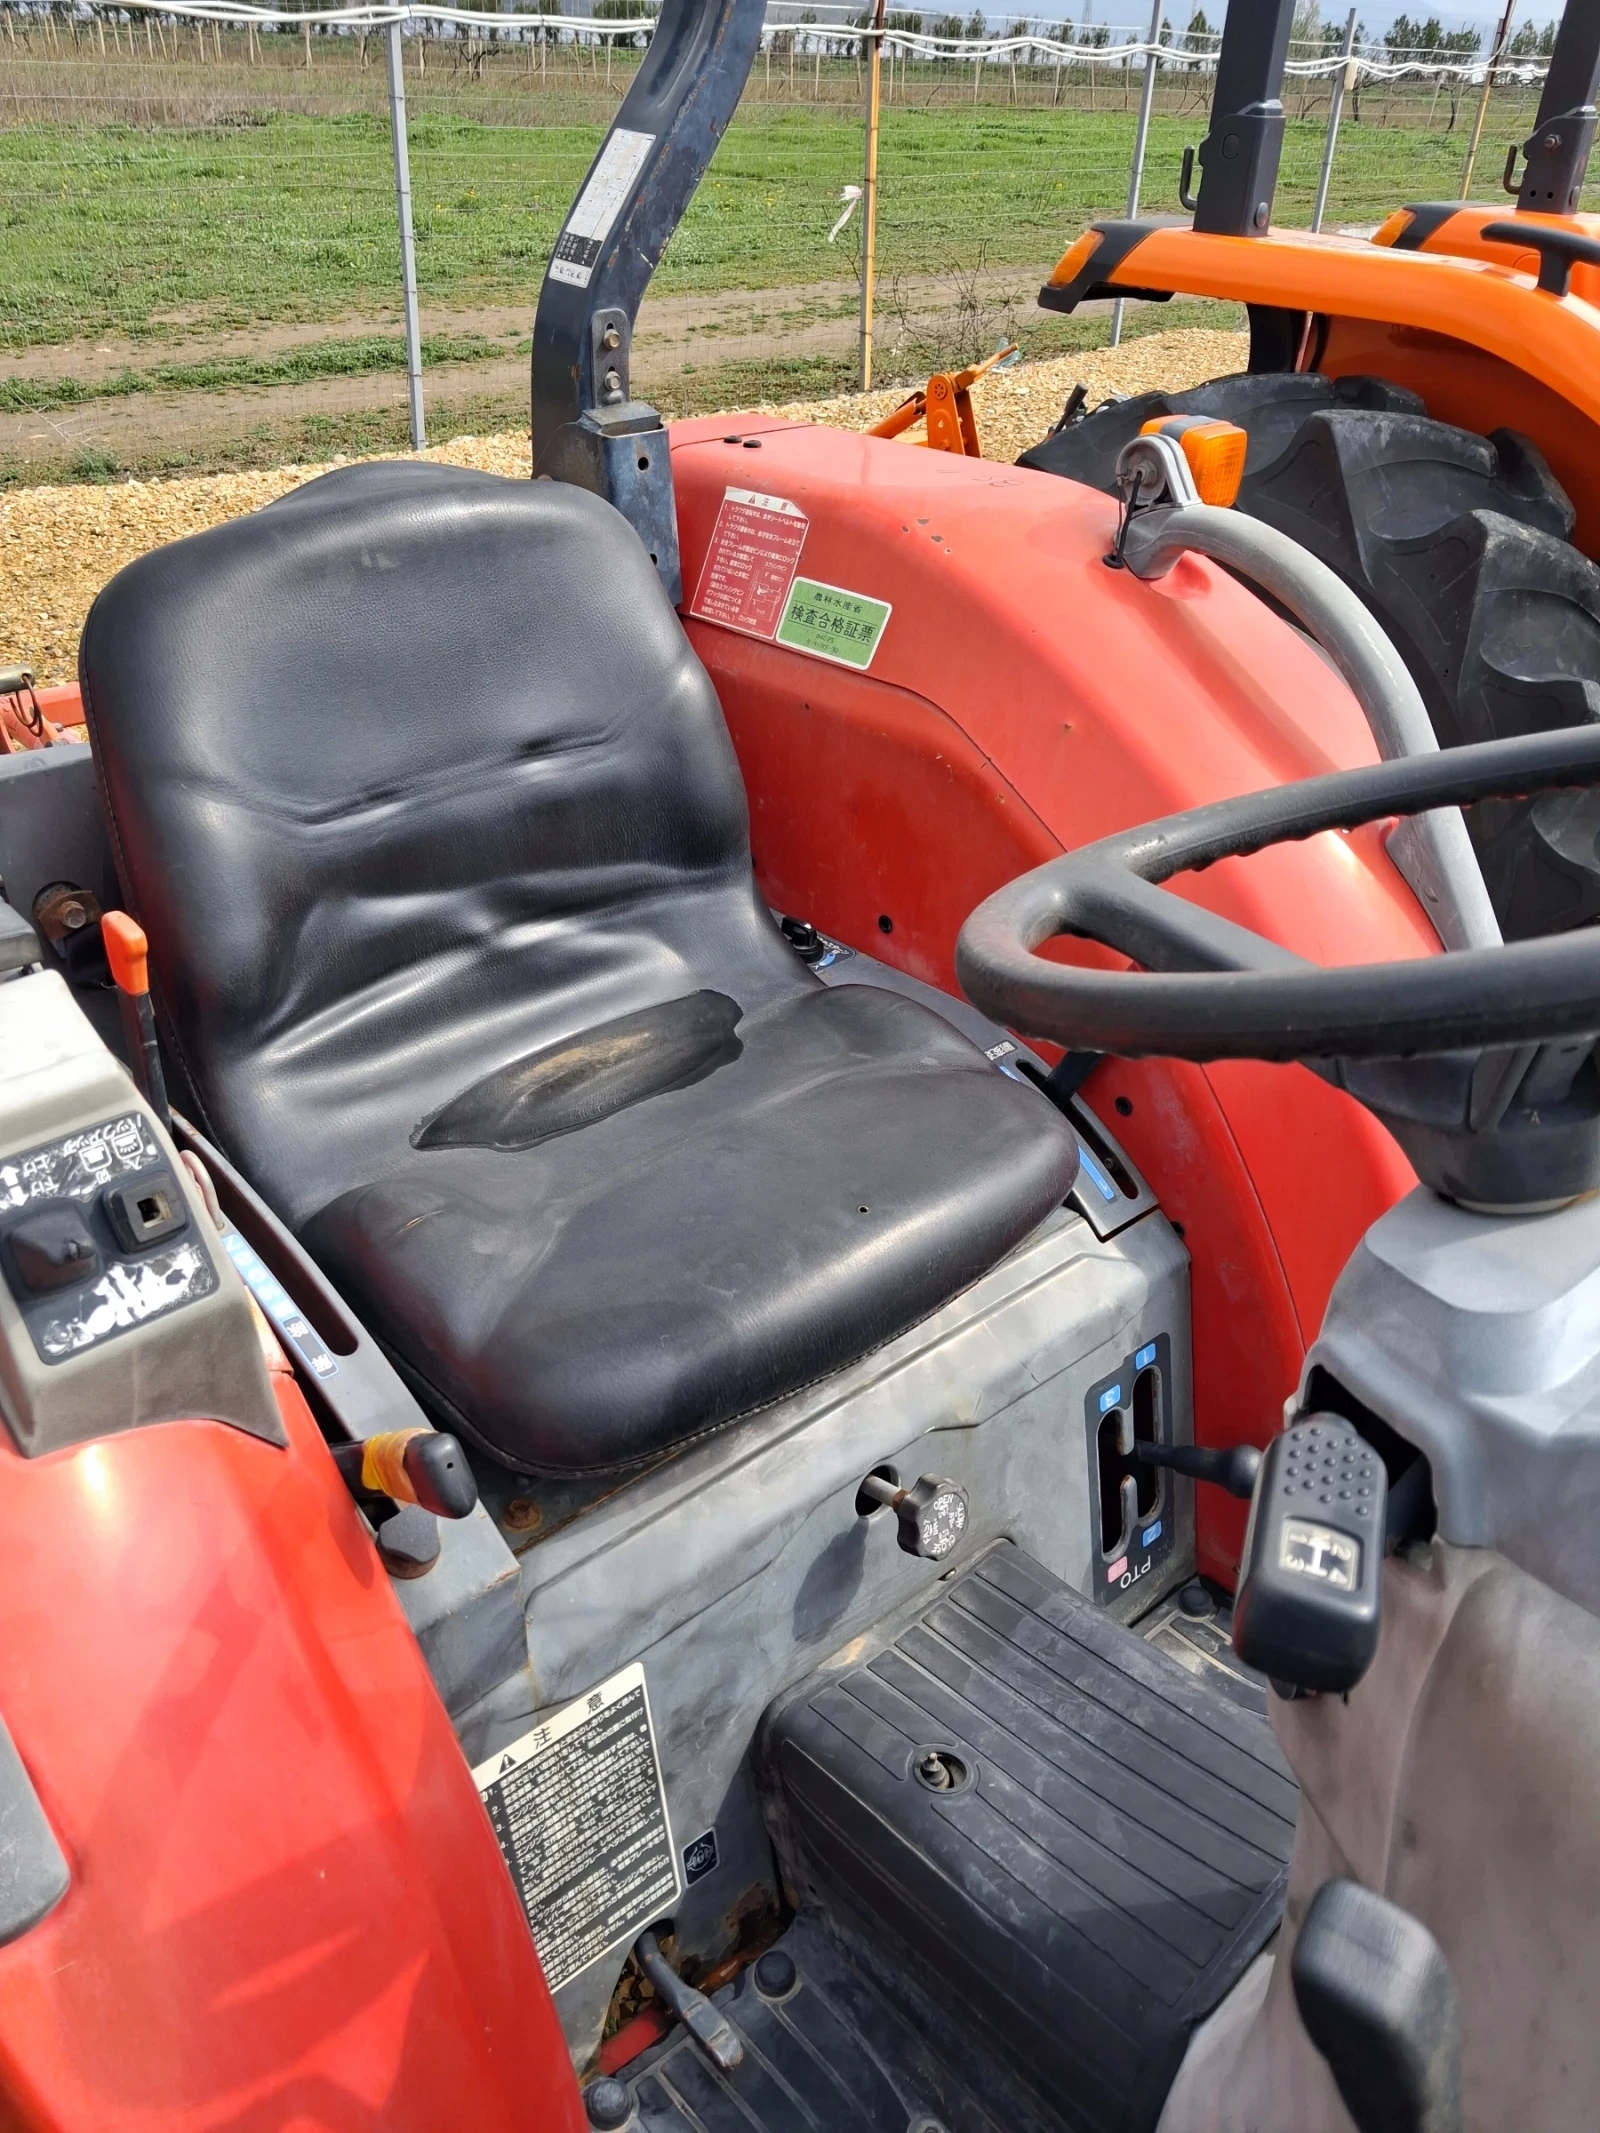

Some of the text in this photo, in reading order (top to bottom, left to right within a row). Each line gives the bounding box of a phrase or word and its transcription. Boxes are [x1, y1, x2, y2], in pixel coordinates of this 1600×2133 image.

[813, 592, 863, 614] 農林水産省
[791, 603, 876, 643] 検査合格証票
[933, 1493, 954, 1511] OPEN
[931, 1534, 956, 1554] CLOSE
[1120, 1554, 1151, 1588] PTO
[533, 1691, 605, 1750] 注 意
